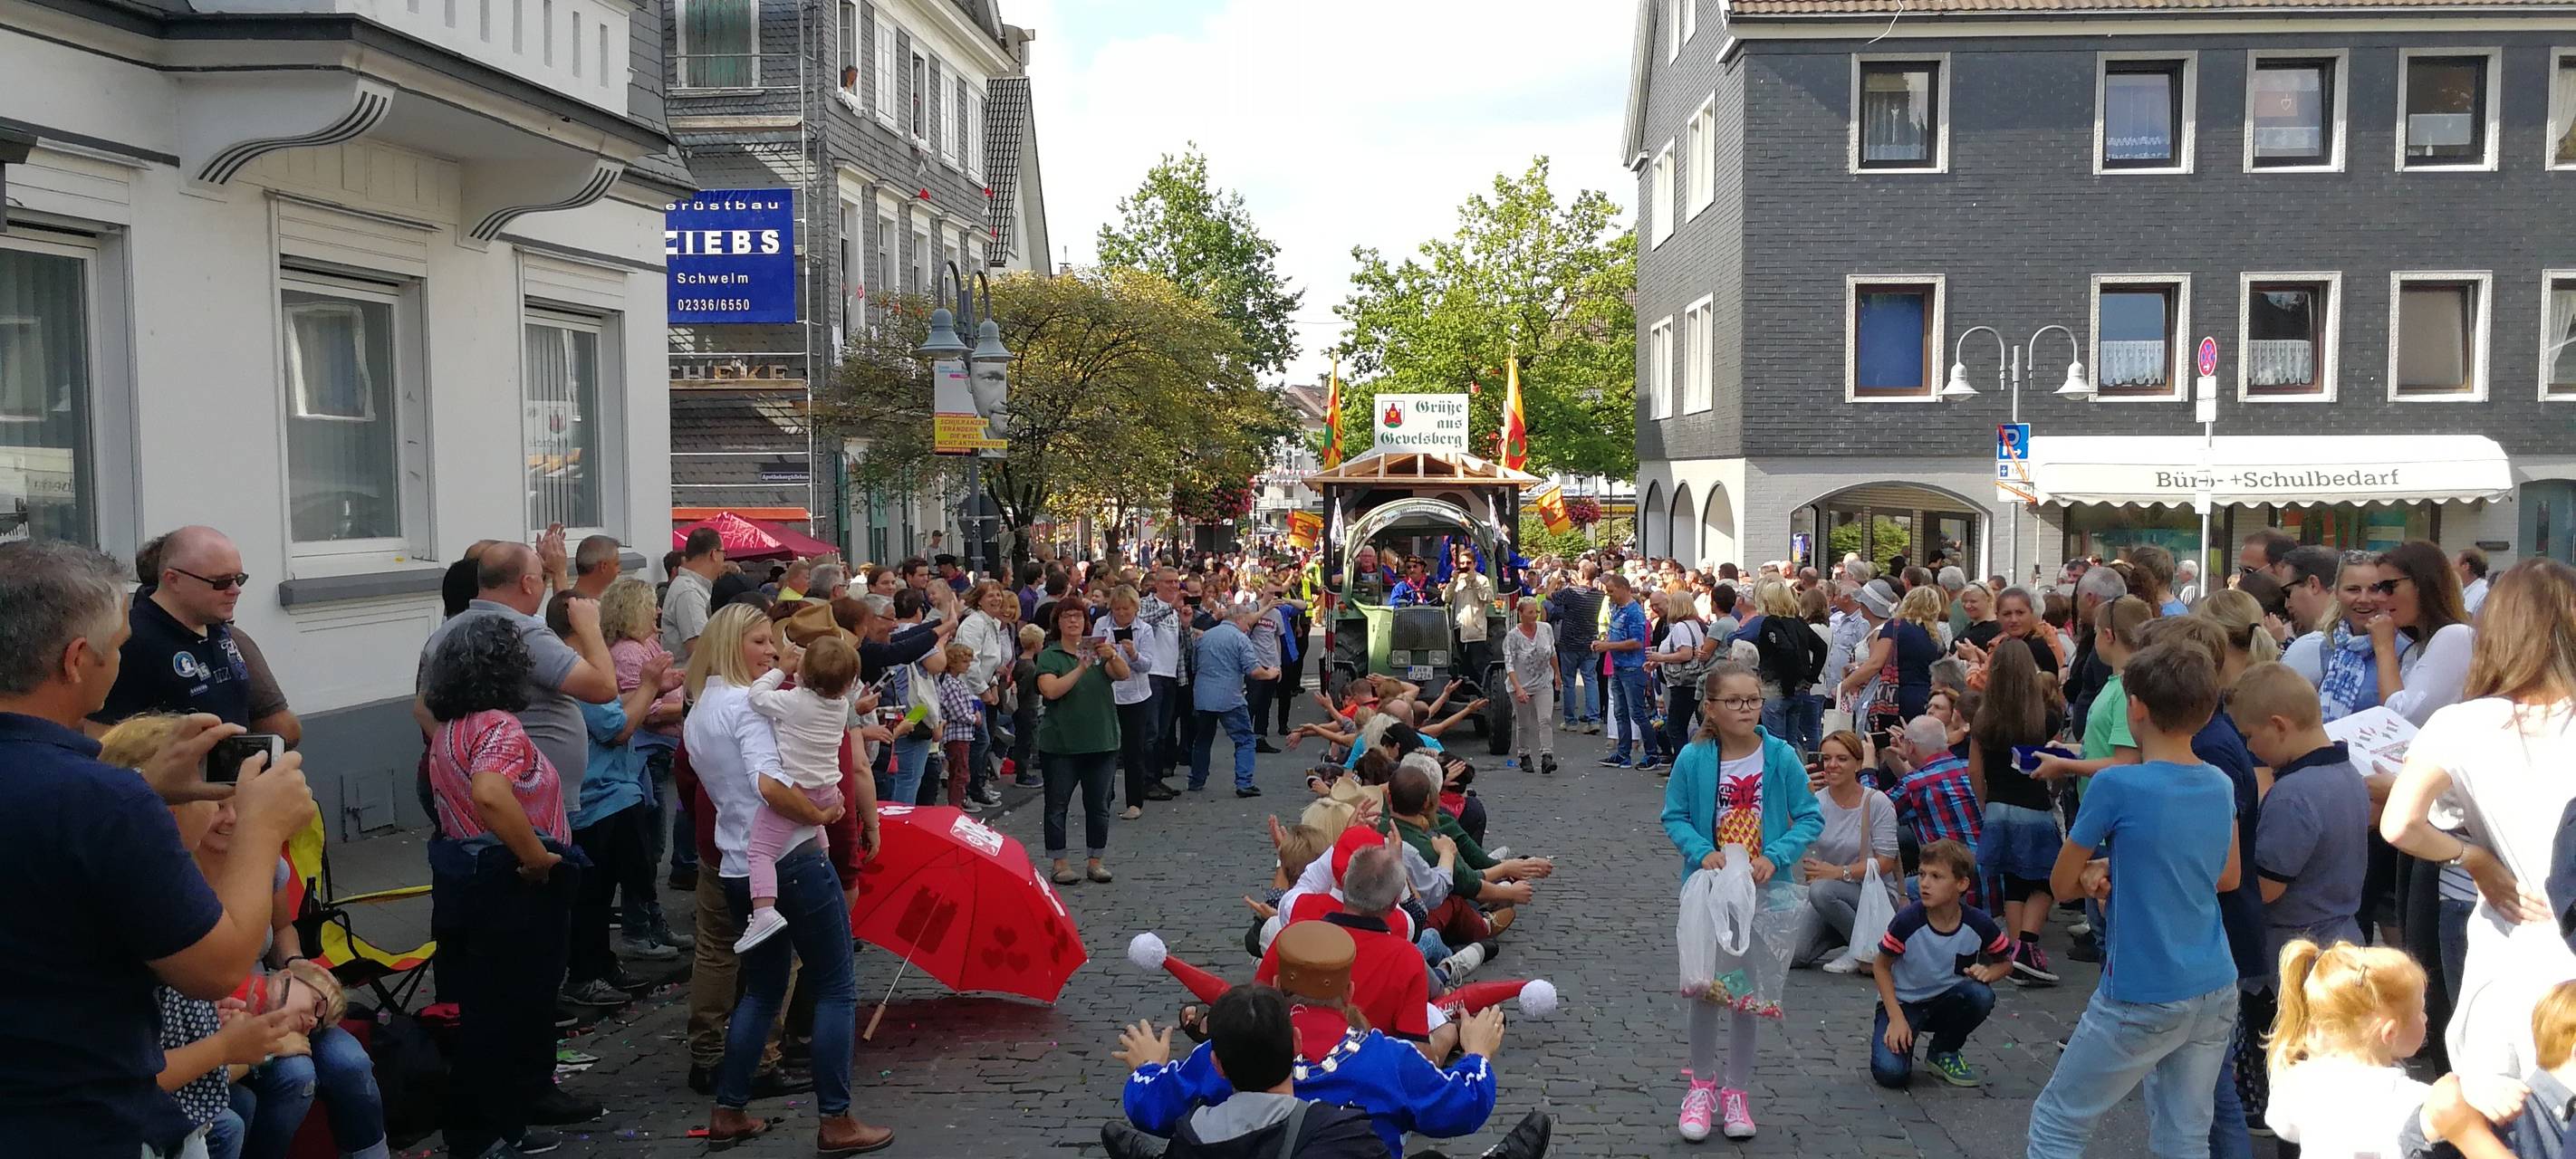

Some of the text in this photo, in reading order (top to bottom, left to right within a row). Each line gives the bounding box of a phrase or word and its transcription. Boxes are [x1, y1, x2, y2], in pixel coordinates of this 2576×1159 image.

[677, 273, 749, 284] Schwelm
[678, 299, 750, 311] 02336/6550
[1416, 400, 1463, 417] Grüße
[1437, 419, 1463, 429] aus
[1380, 431, 1463, 448] Gevelsberg
[2230, 469, 2399, 487] +Schulbedarf
